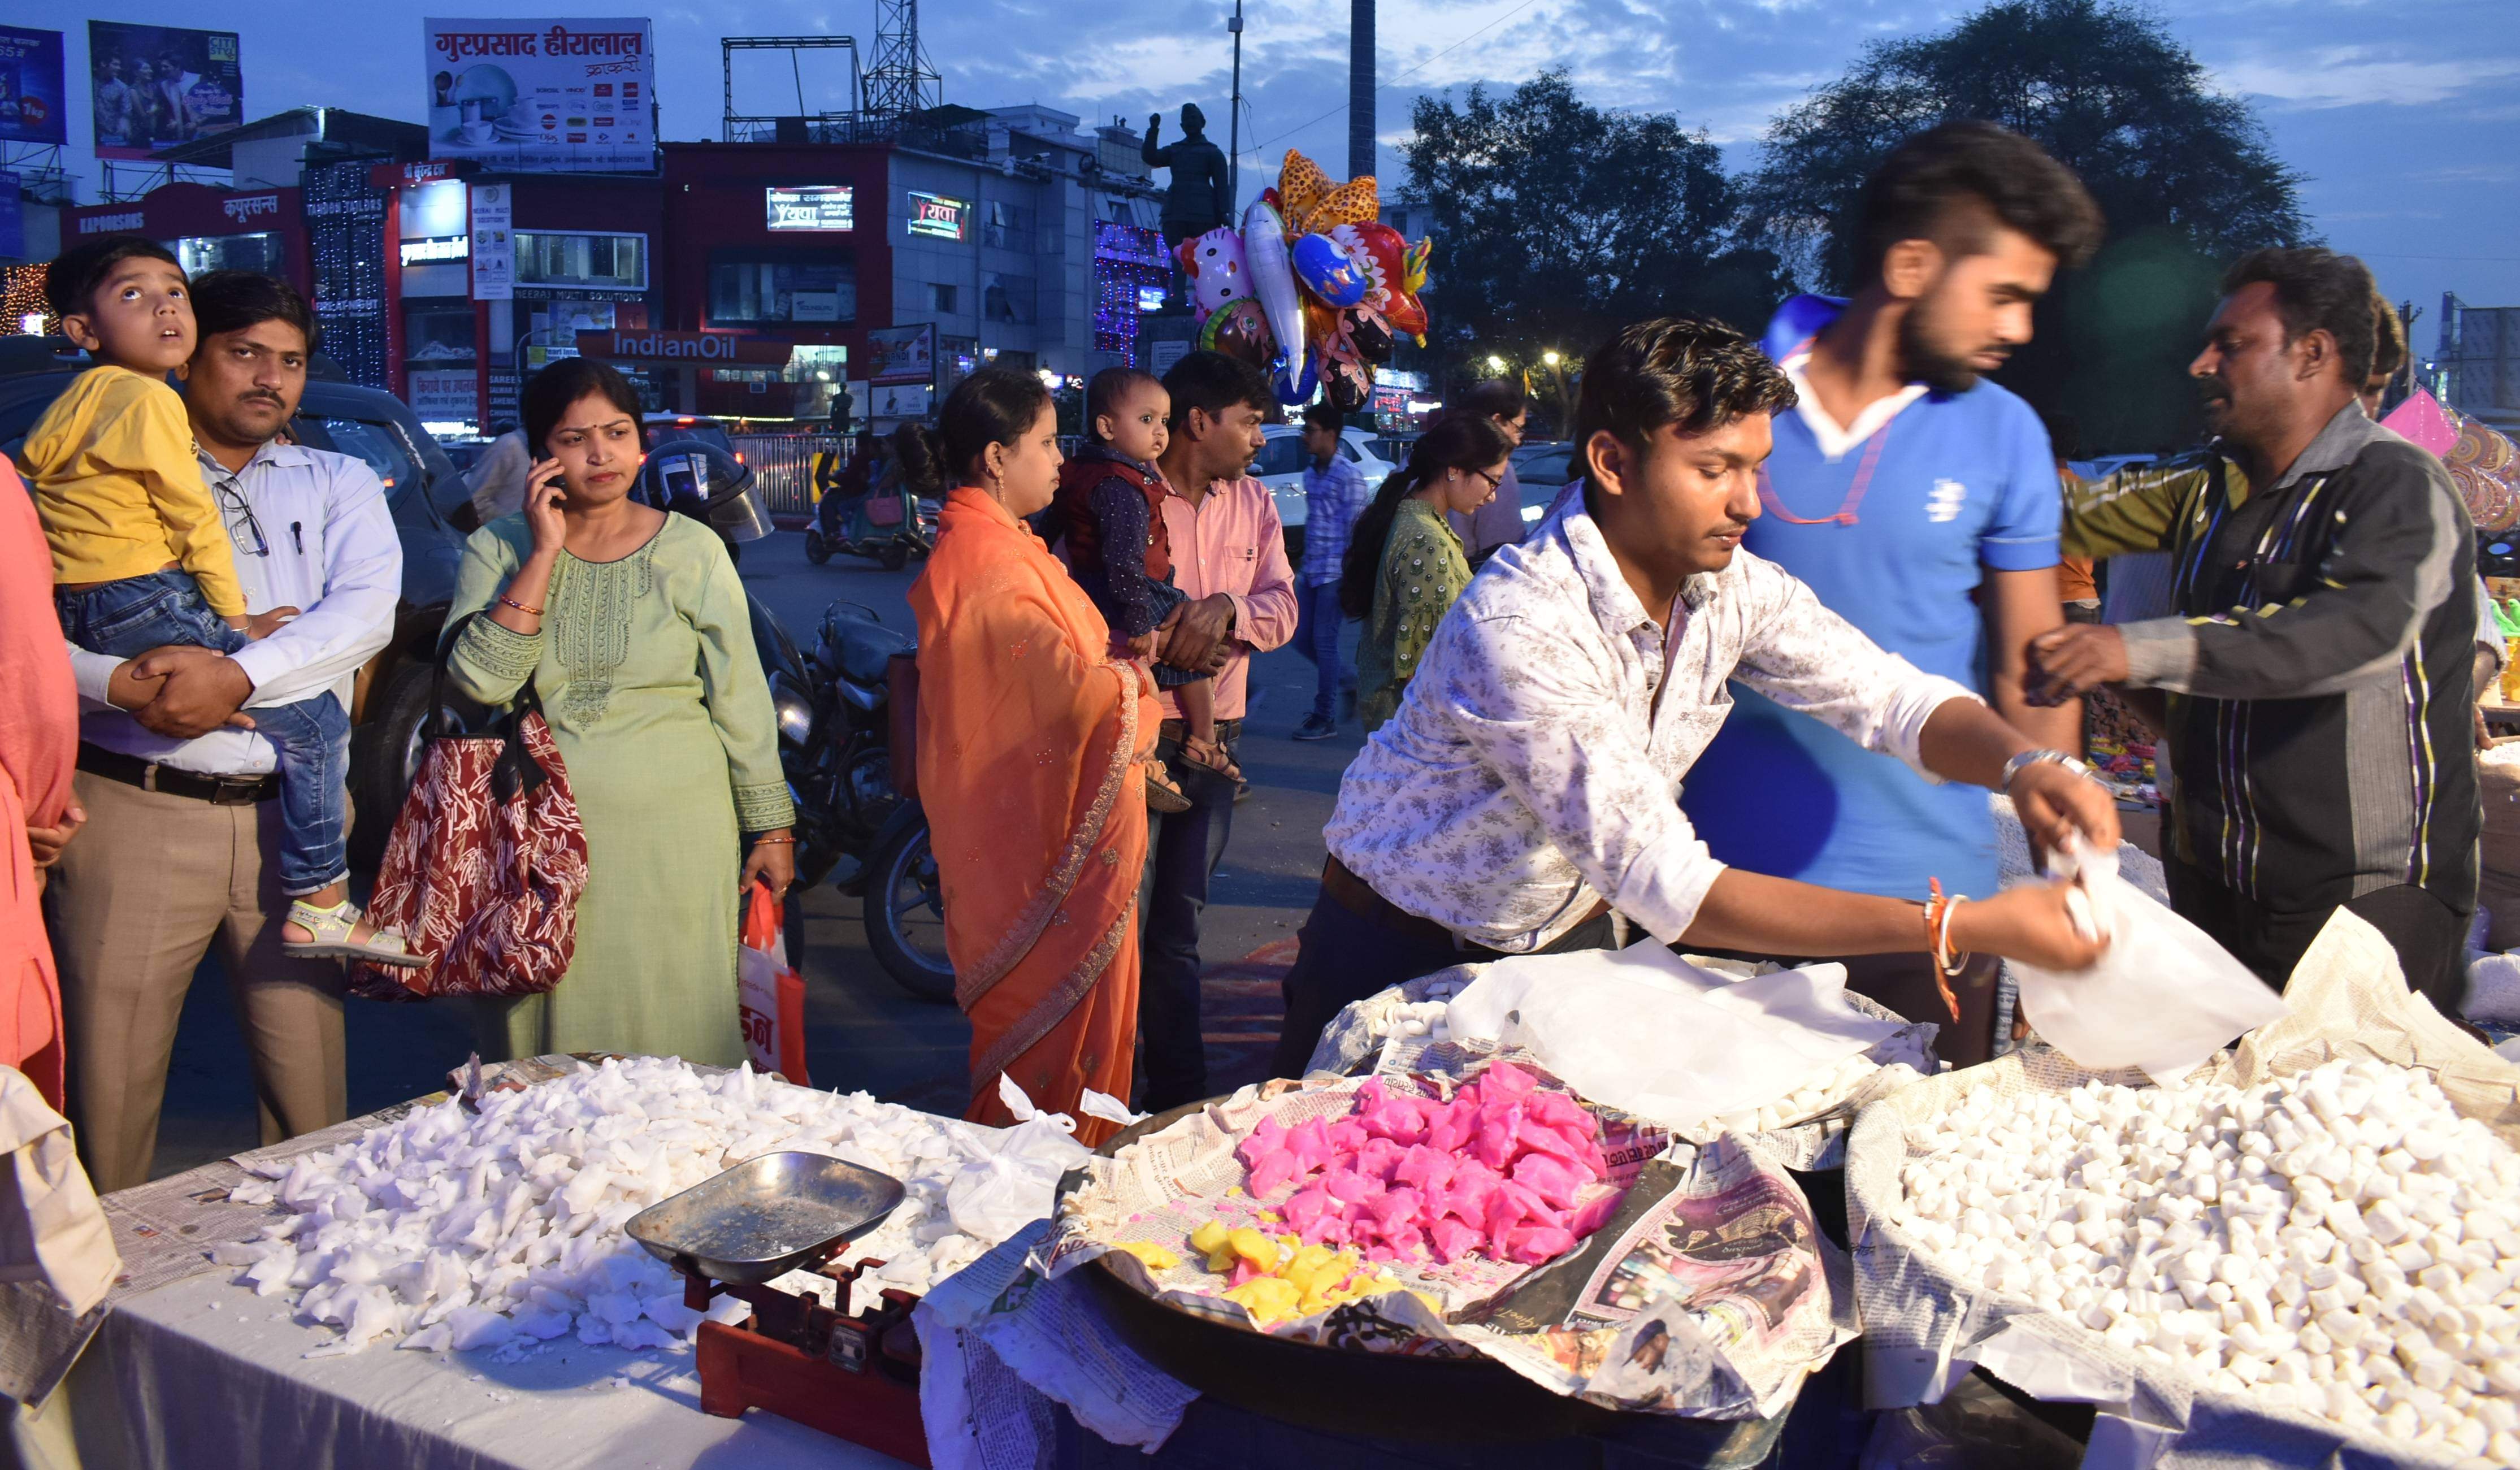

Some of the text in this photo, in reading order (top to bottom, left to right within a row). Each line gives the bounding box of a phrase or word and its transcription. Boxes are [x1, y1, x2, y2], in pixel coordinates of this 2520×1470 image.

[211, 38, 235, 47] CITI
[544, 25, 643, 56] हीरालाल
[223, 196, 278, 223] कपूरसन्स
[515, 290, 642, 302] NEERAJ MULTI SOLUTIONS
[614, 332, 735, 358] IndianOil
